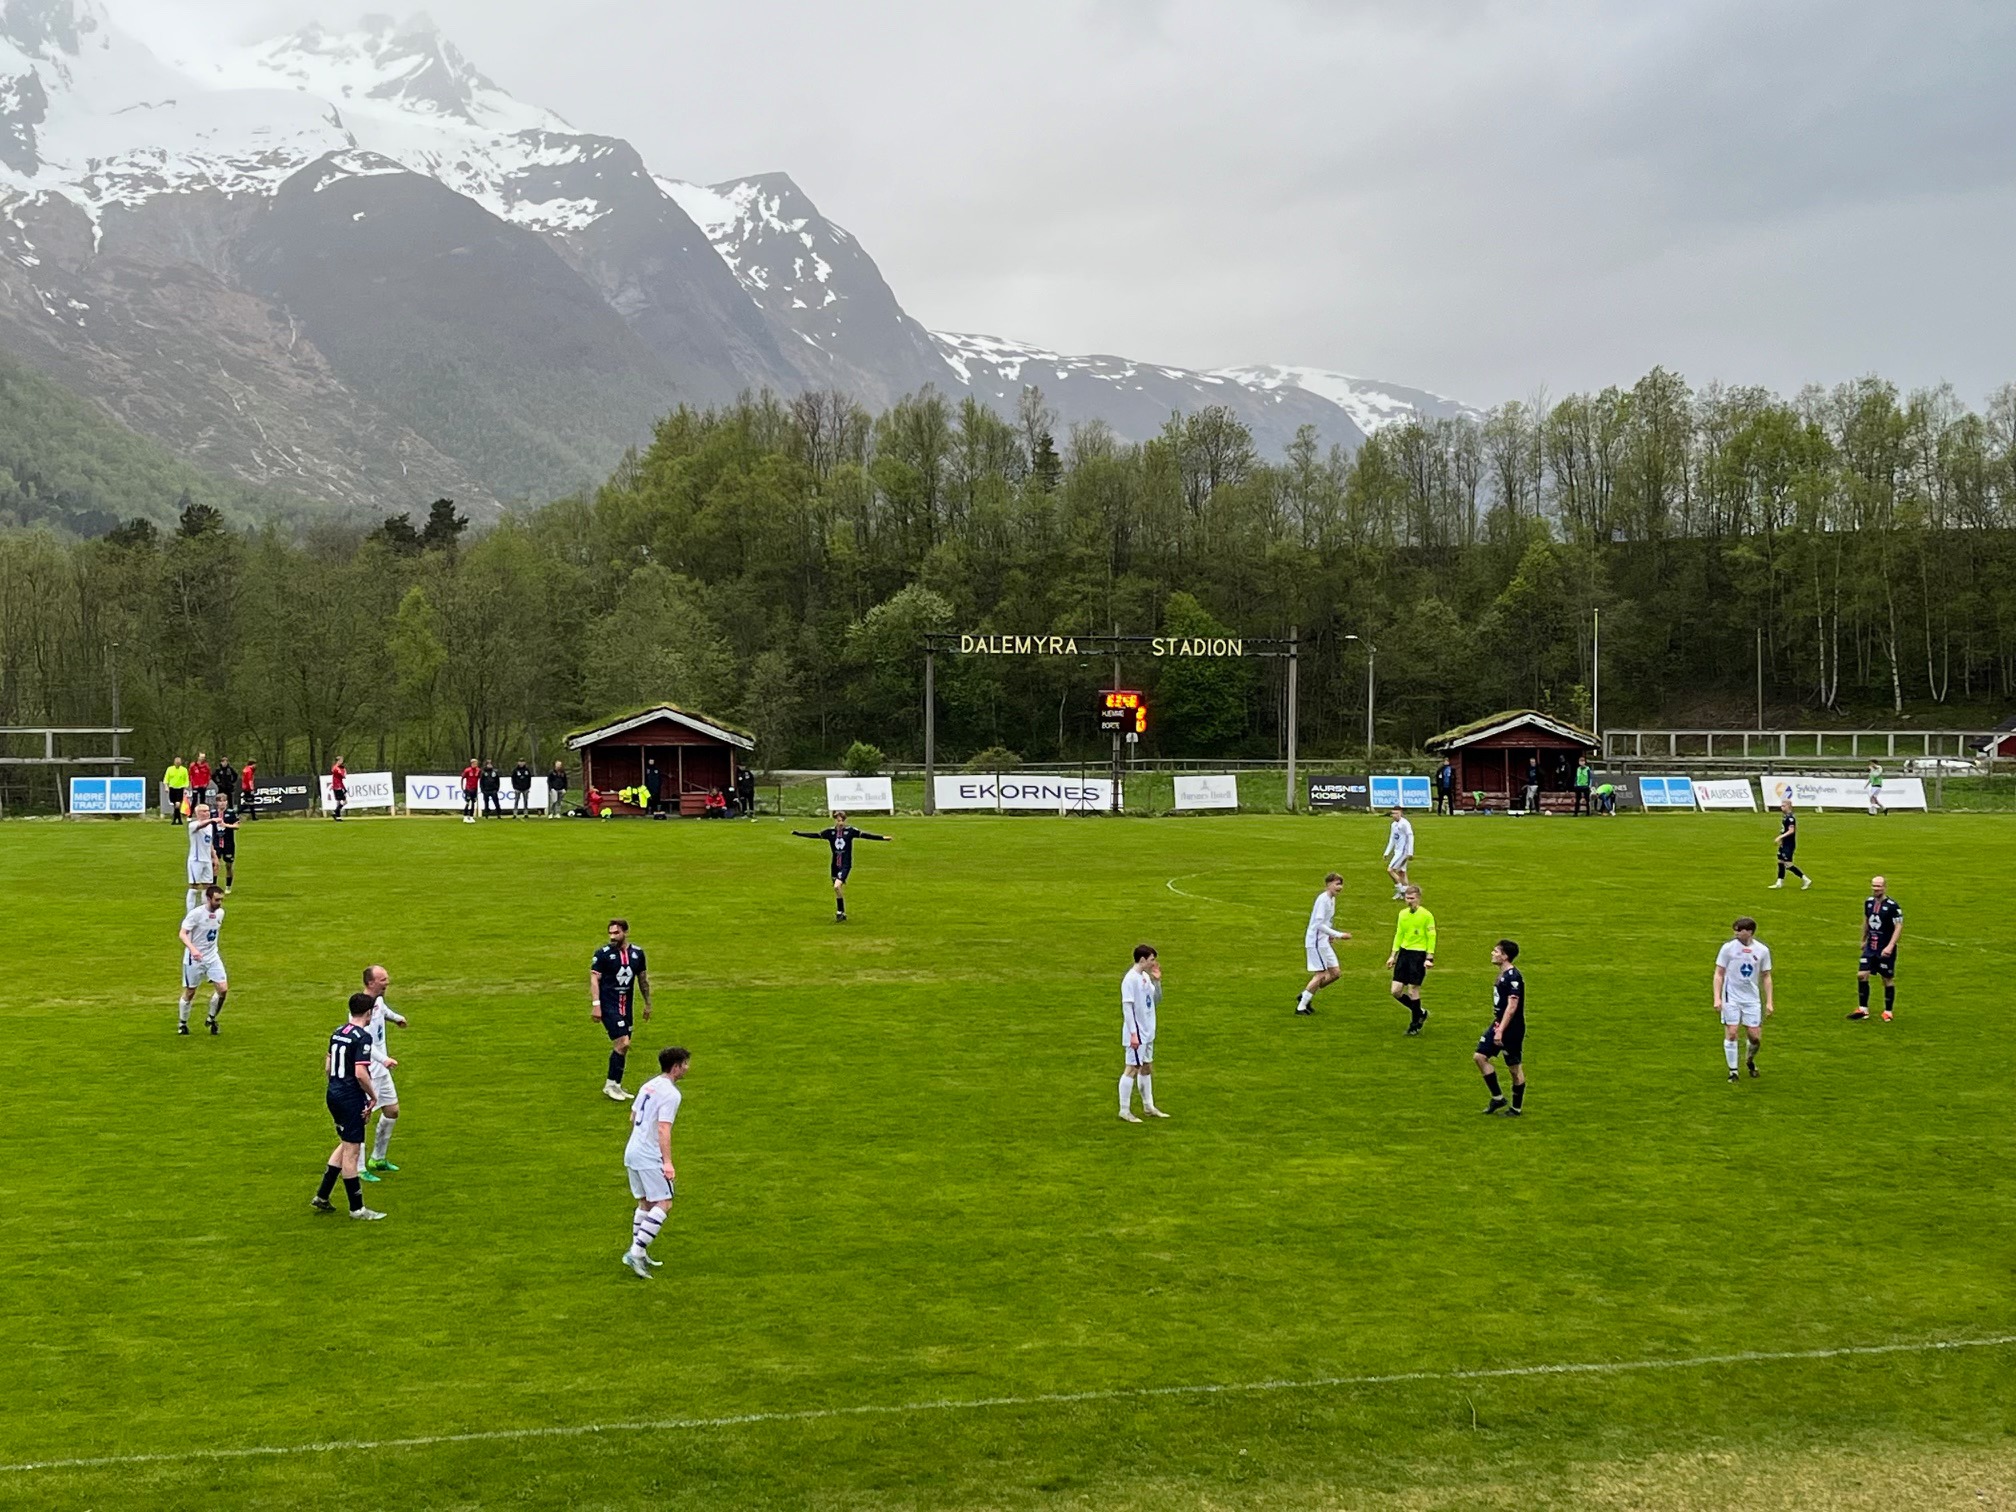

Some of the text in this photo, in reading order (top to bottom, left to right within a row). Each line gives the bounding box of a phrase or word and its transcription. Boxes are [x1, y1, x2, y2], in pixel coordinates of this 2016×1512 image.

[961, 635, 1242, 657] DALEMYRA STADION
[346, 784, 389, 798] URSNES
[412, 785, 440, 800] VD
[959, 784, 1100, 801] EKORNES
[1311, 785, 1367, 793] AURSNES
[1711, 788, 1750, 799] AURSNES
[74, 793, 105, 801] MØRE
[112, 793, 142, 801] MØRE
[330, 1043, 347, 1078] 11
